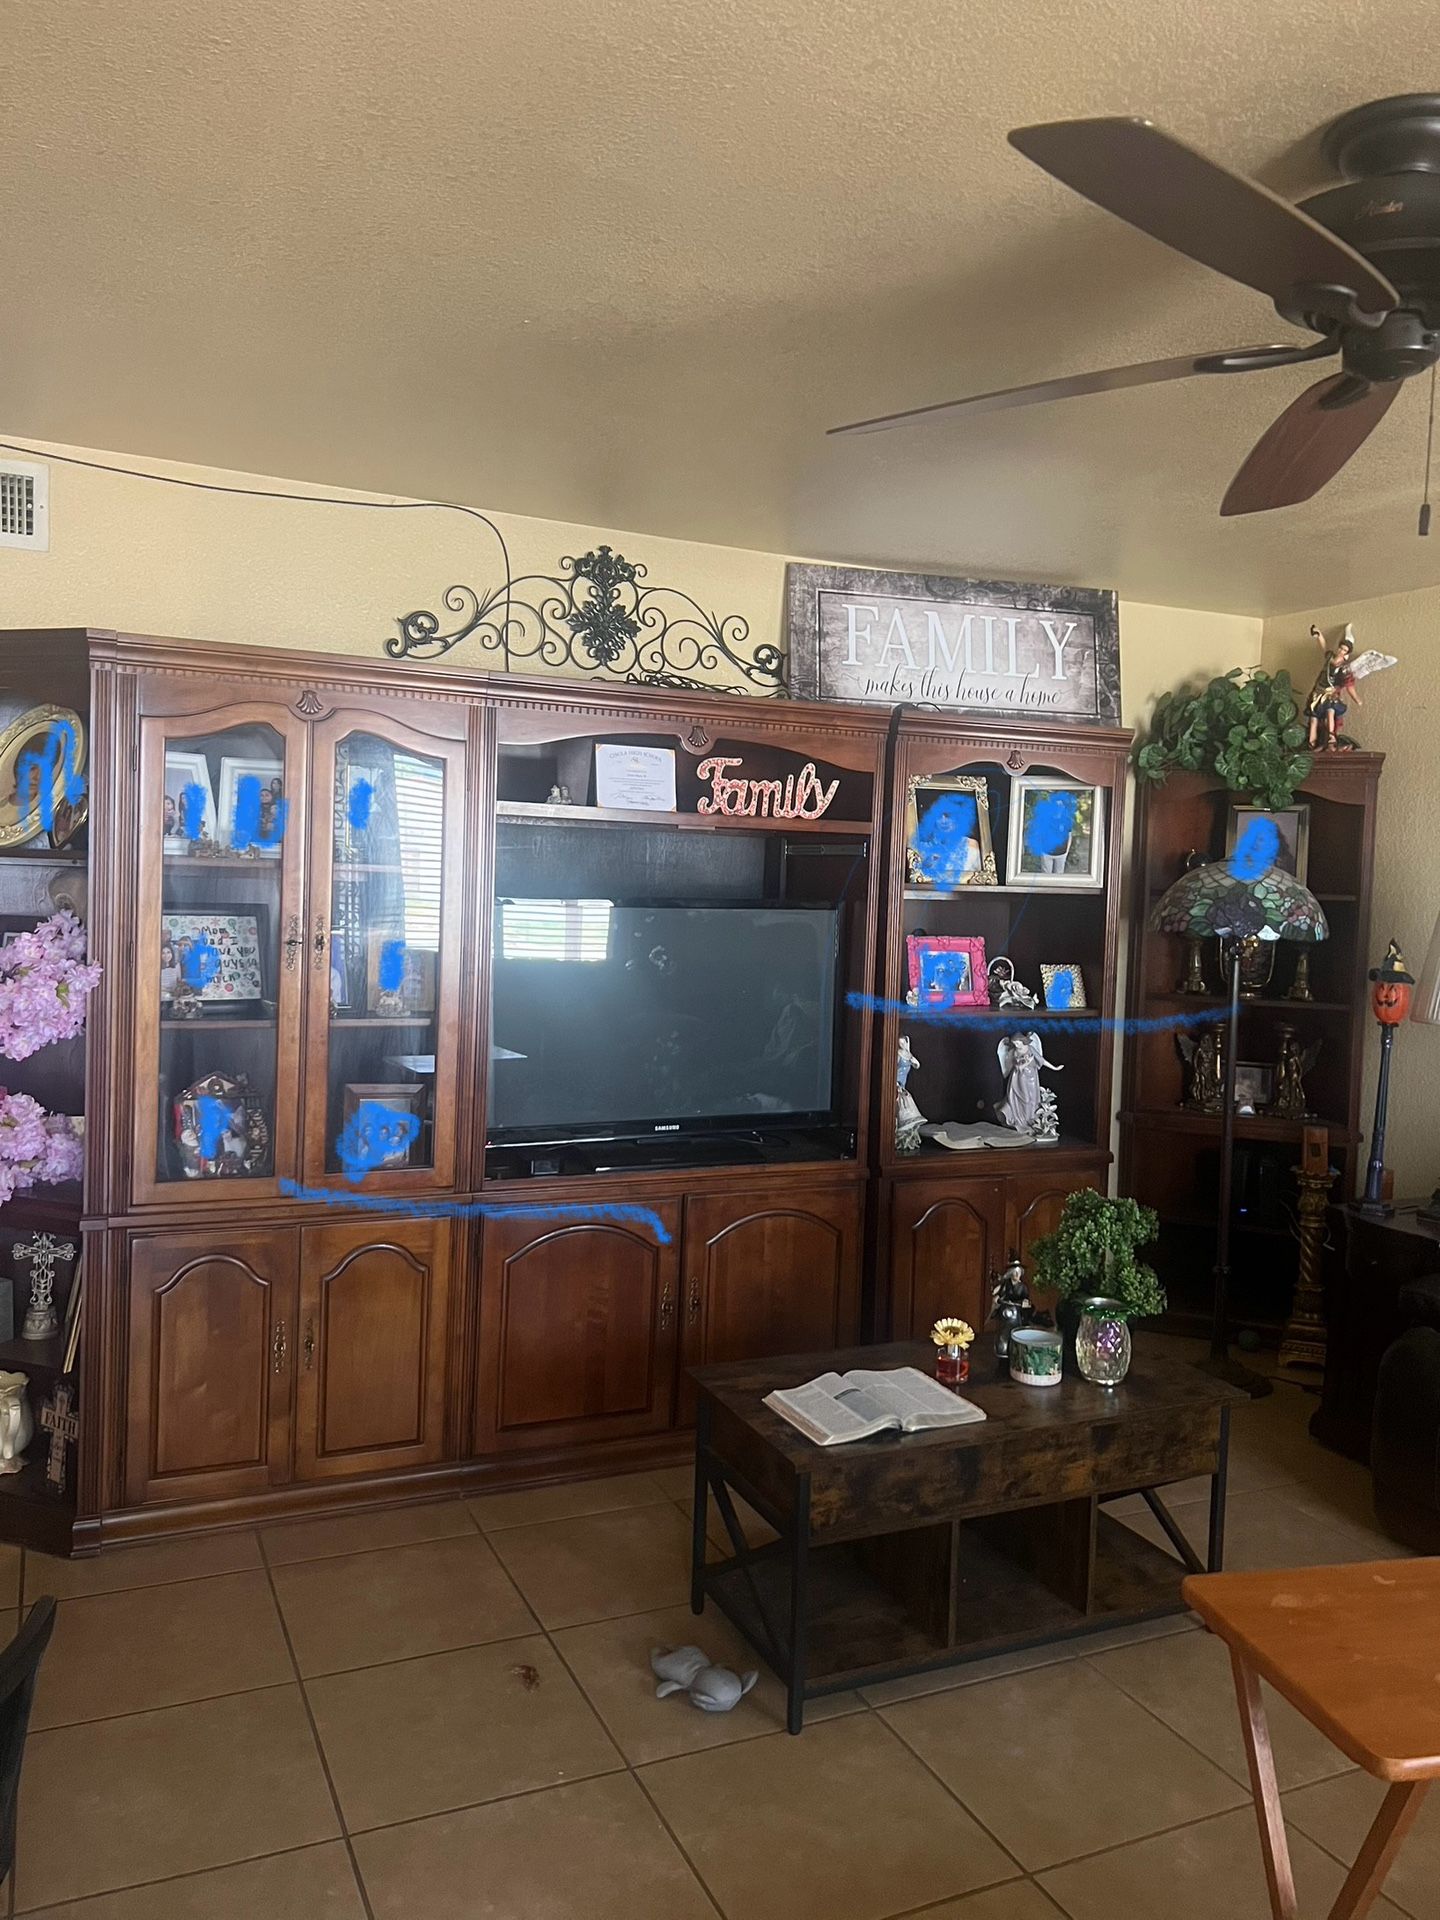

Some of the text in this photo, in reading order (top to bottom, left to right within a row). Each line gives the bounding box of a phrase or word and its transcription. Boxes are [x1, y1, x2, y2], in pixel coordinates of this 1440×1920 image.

[842, 603, 1078, 681] FAMILY
[864, 663, 1063, 707] makes this house a home
[696, 757, 840, 820] Family
[45, 1410, 76, 1436] FAITH
